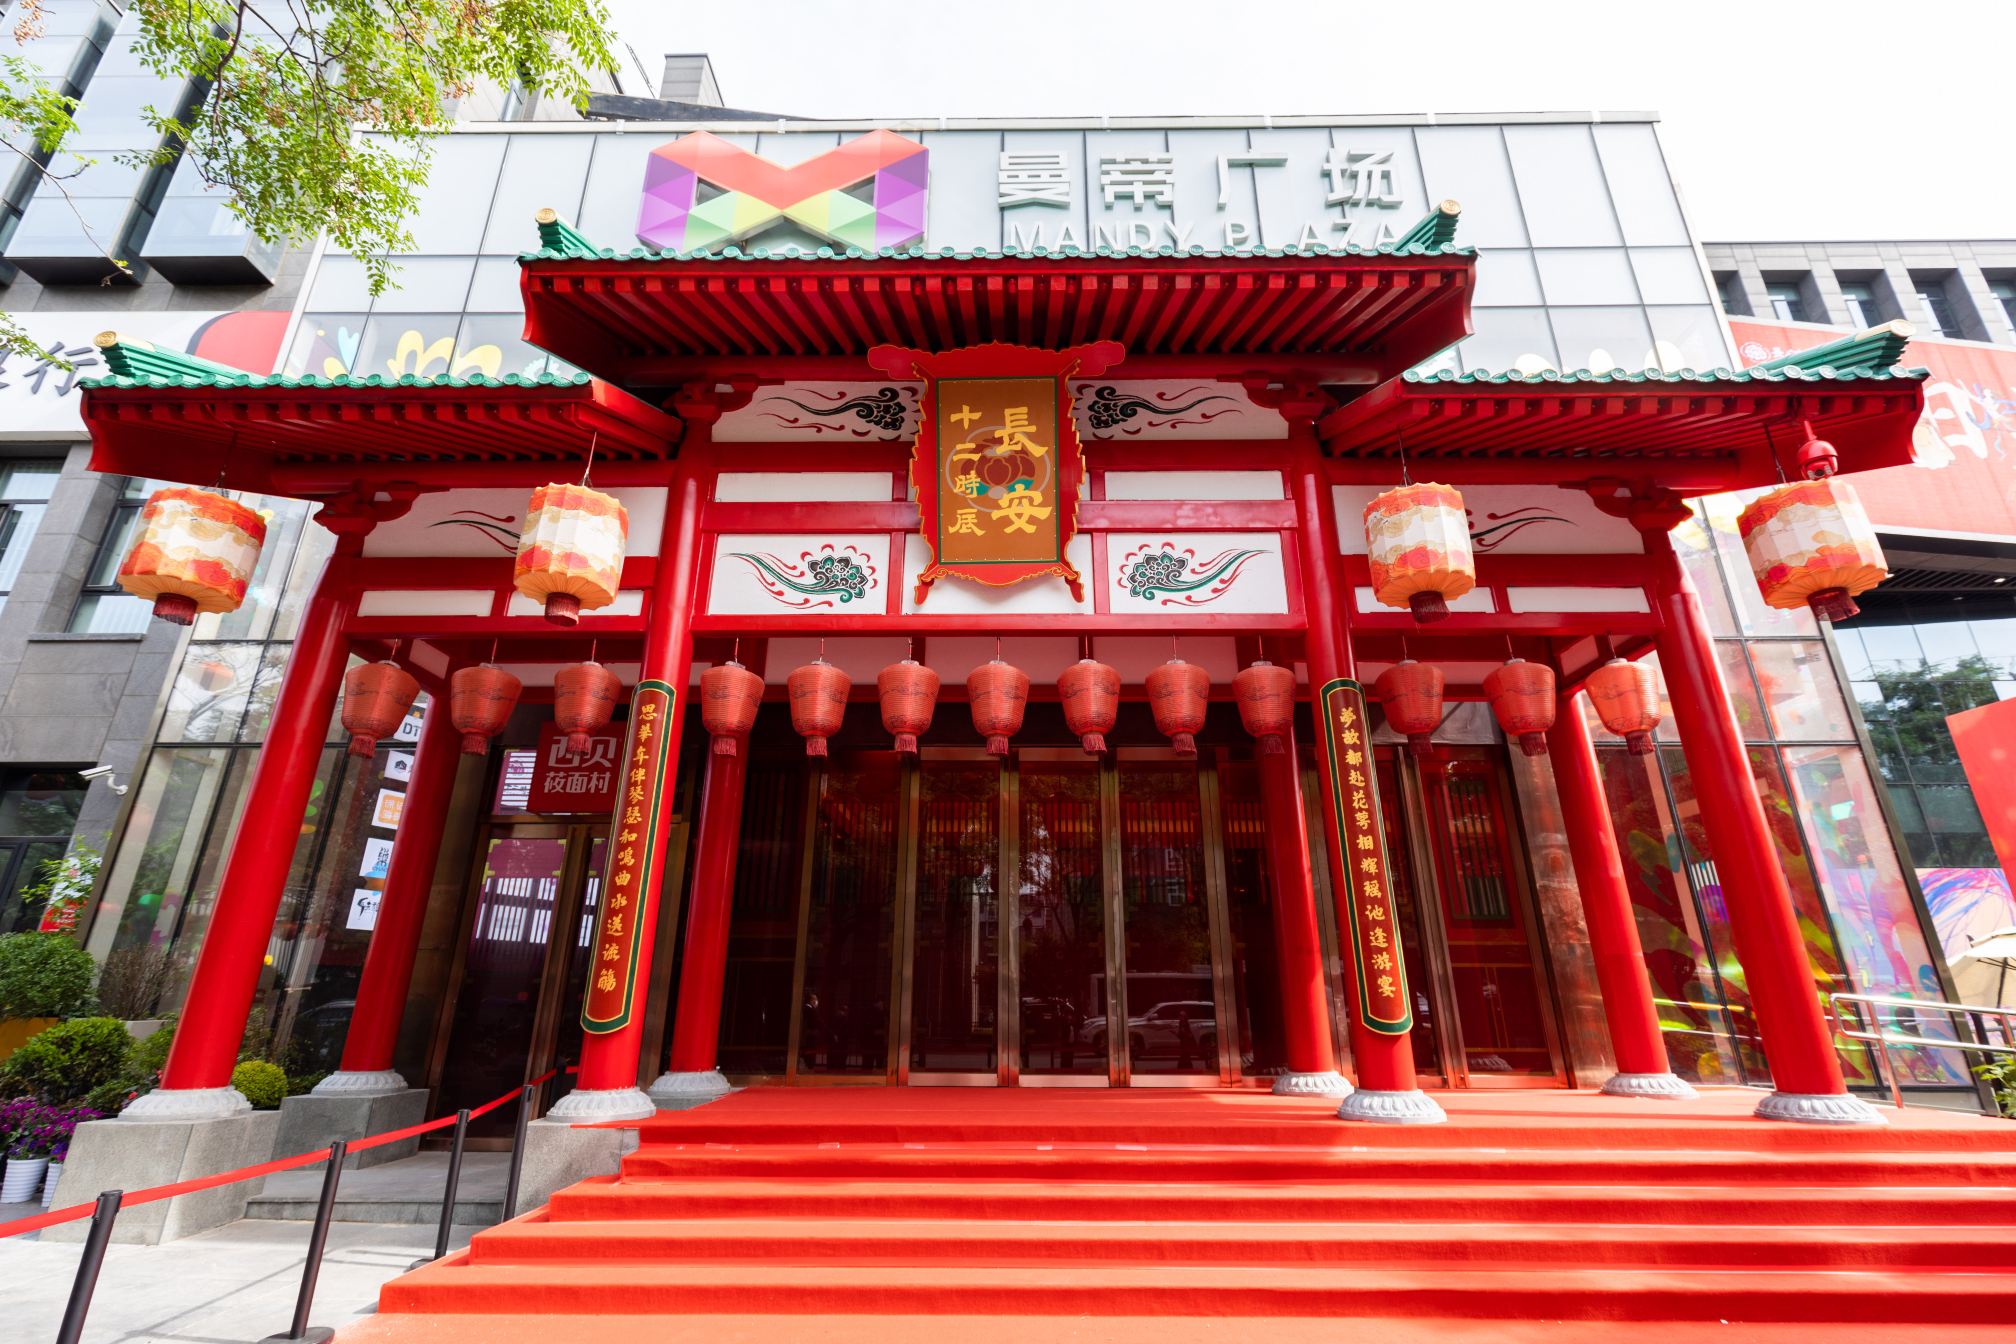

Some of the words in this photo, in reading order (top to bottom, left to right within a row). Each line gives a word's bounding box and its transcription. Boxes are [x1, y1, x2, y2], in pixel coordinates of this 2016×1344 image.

[998, 149, 1404, 211] 曼蒂广场
[1008, 220, 1195, 253] MANDY
[1223, 219, 1397, 251] PAZA
[948, 404, 986, 537] 十二時辰
[991, 406, 1053, 534] 長安
[548, 736, 617, 768] 西贝
[543, 771, 611, 794] 莜面村
